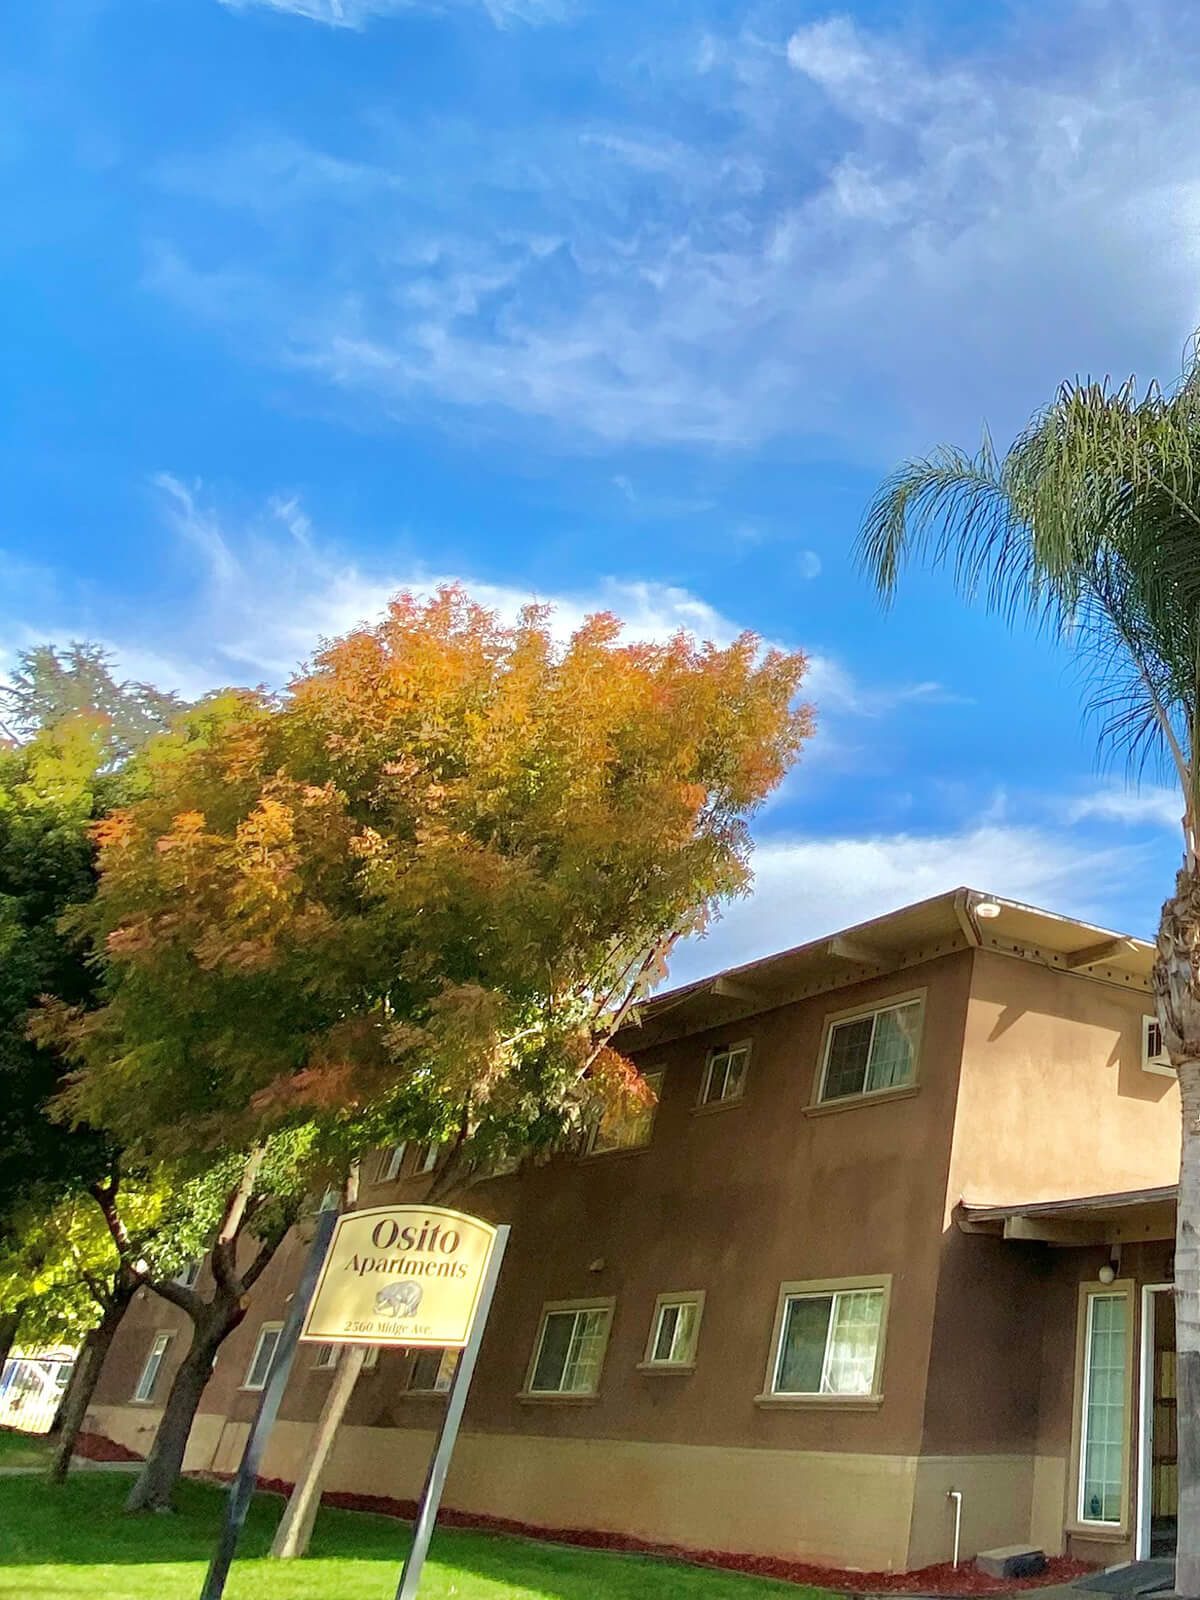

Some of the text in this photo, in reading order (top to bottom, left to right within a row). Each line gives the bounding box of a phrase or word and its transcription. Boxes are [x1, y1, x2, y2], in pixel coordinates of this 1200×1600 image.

[371, 1218, 461, 1255] Osito
[344, 1253, 469, 1279] Apartments
[376, 1322, 409, 1336] Midge
